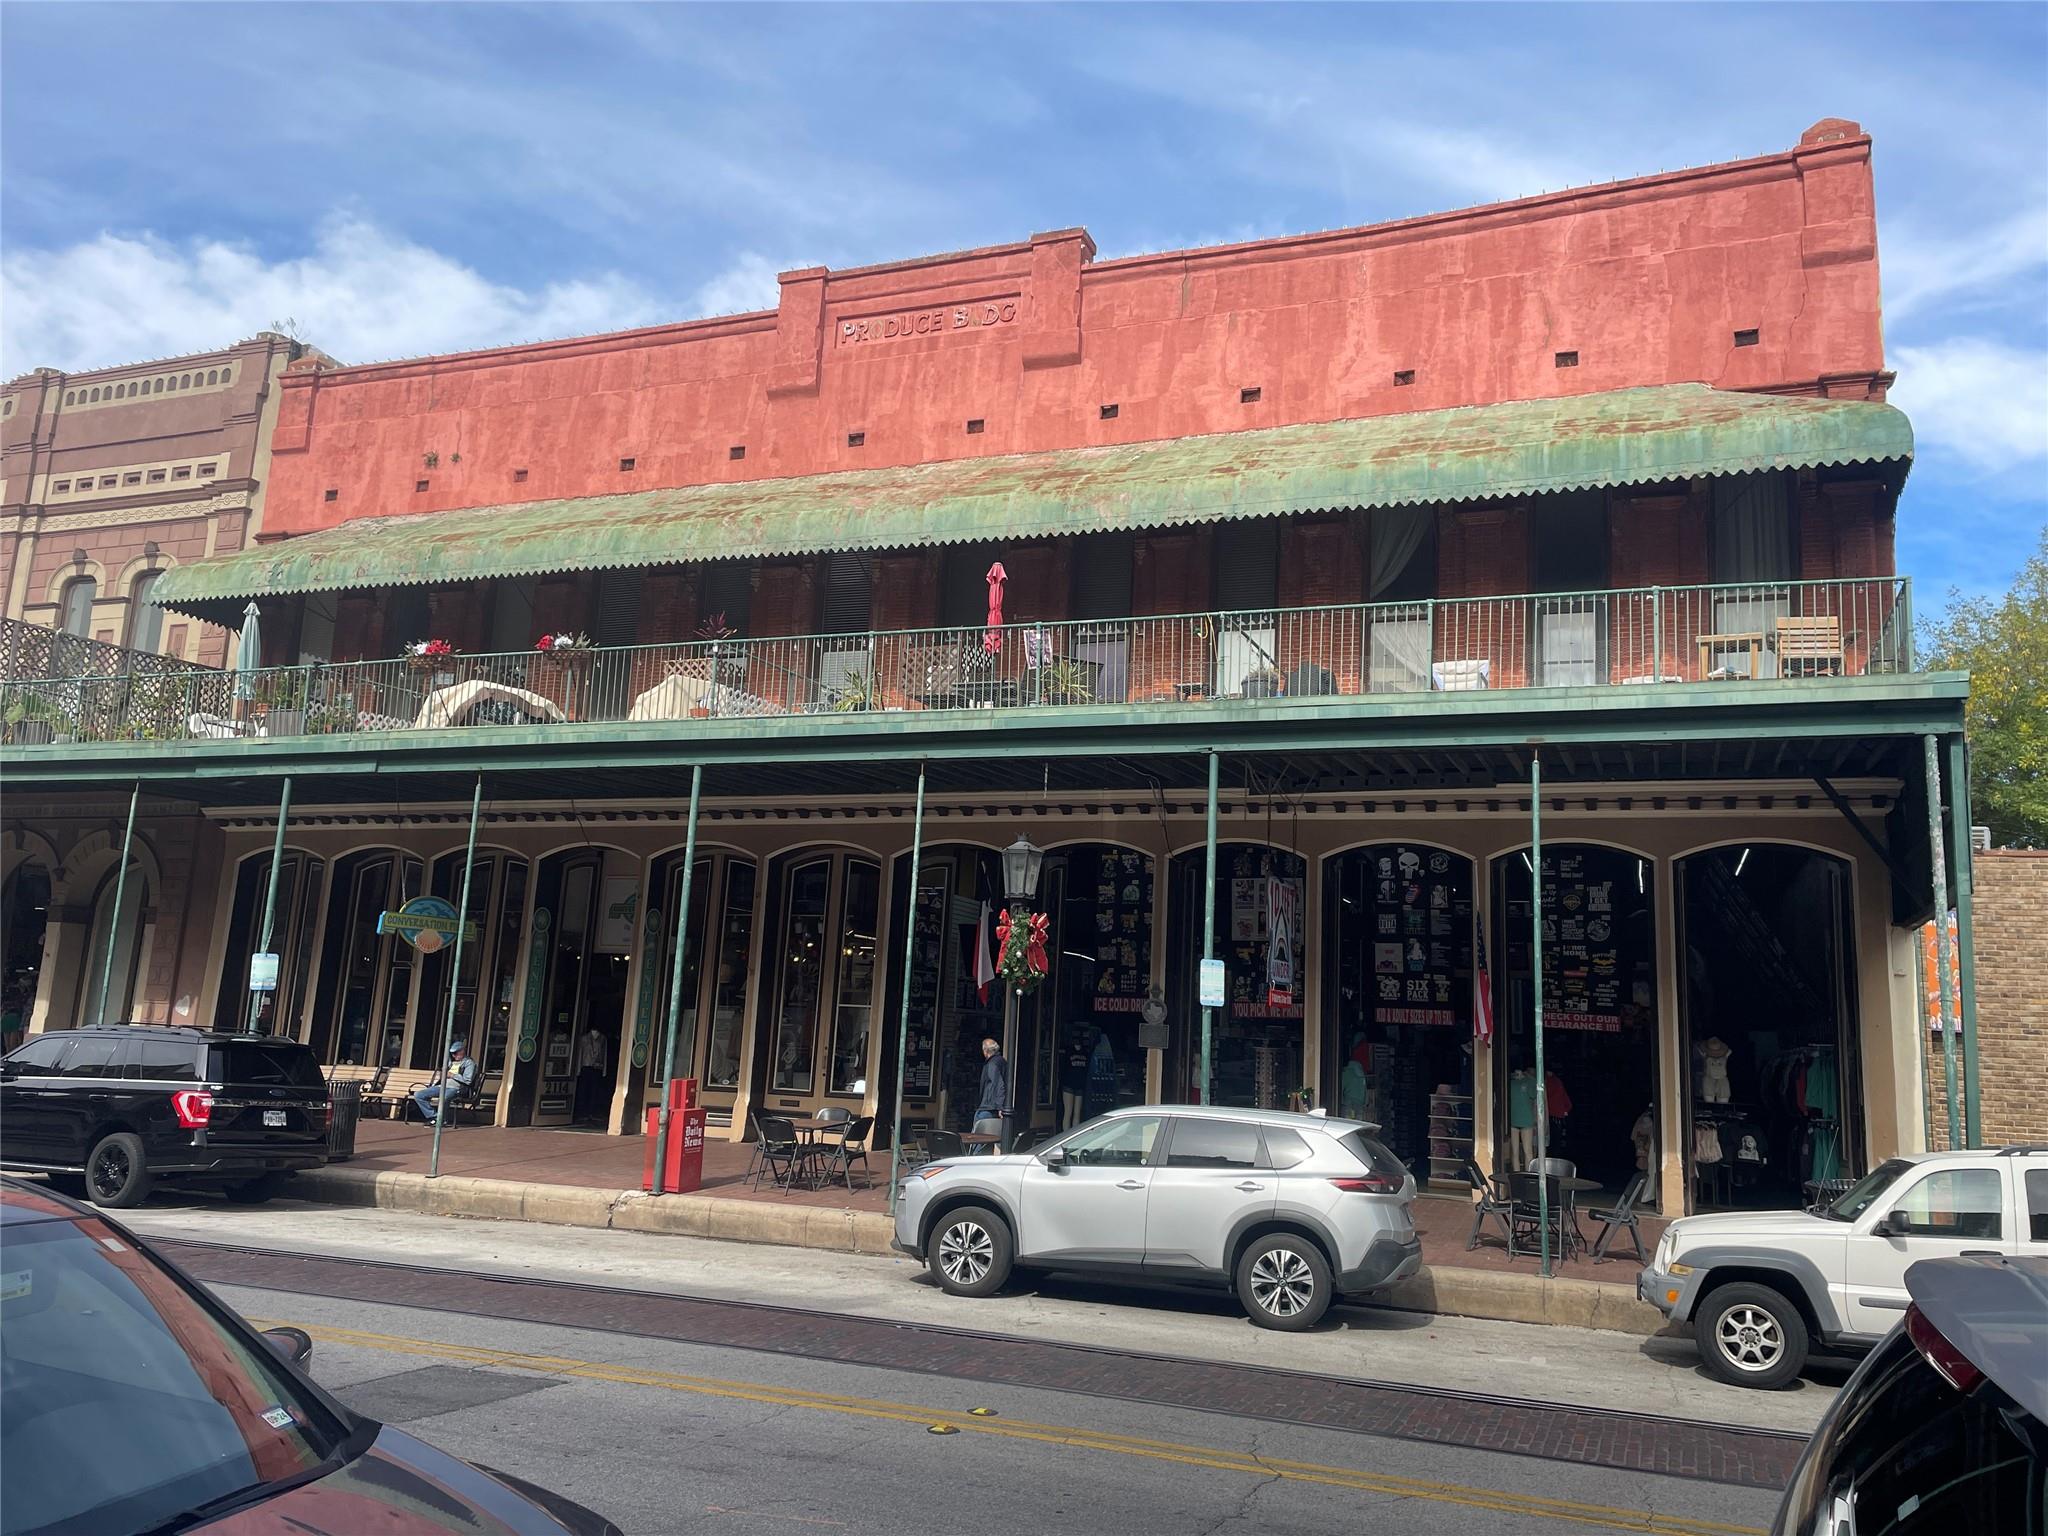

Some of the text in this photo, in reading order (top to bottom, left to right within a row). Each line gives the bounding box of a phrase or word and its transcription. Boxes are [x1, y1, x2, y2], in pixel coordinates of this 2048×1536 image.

[387, 915, 447, 929] CONVERSATION
[1407, 980, 1428, 990] SIX
[1407, 991, 1429, 1001] PACK
[1095, 998, 1108, 1011] ICE
[1109, 998, 1129, 1011] COLD
[1234, 1003, 1248, 1017] YOU
[1249, 1003, 1266, 1017] PICK
[1282, 1003, 1303, 1018] PRINT
[1410, 1009, 1425, 1024] SIZES
[1544, 1012, 1618, 1023] HECK OUT OUR
[1544, 1021, 1603, 1031] LEARANCE
[544, 1082, 568, 1094] 2114
[689, 1117, 699, 1125] The
[685, 1126, 703, 1137] Daily
